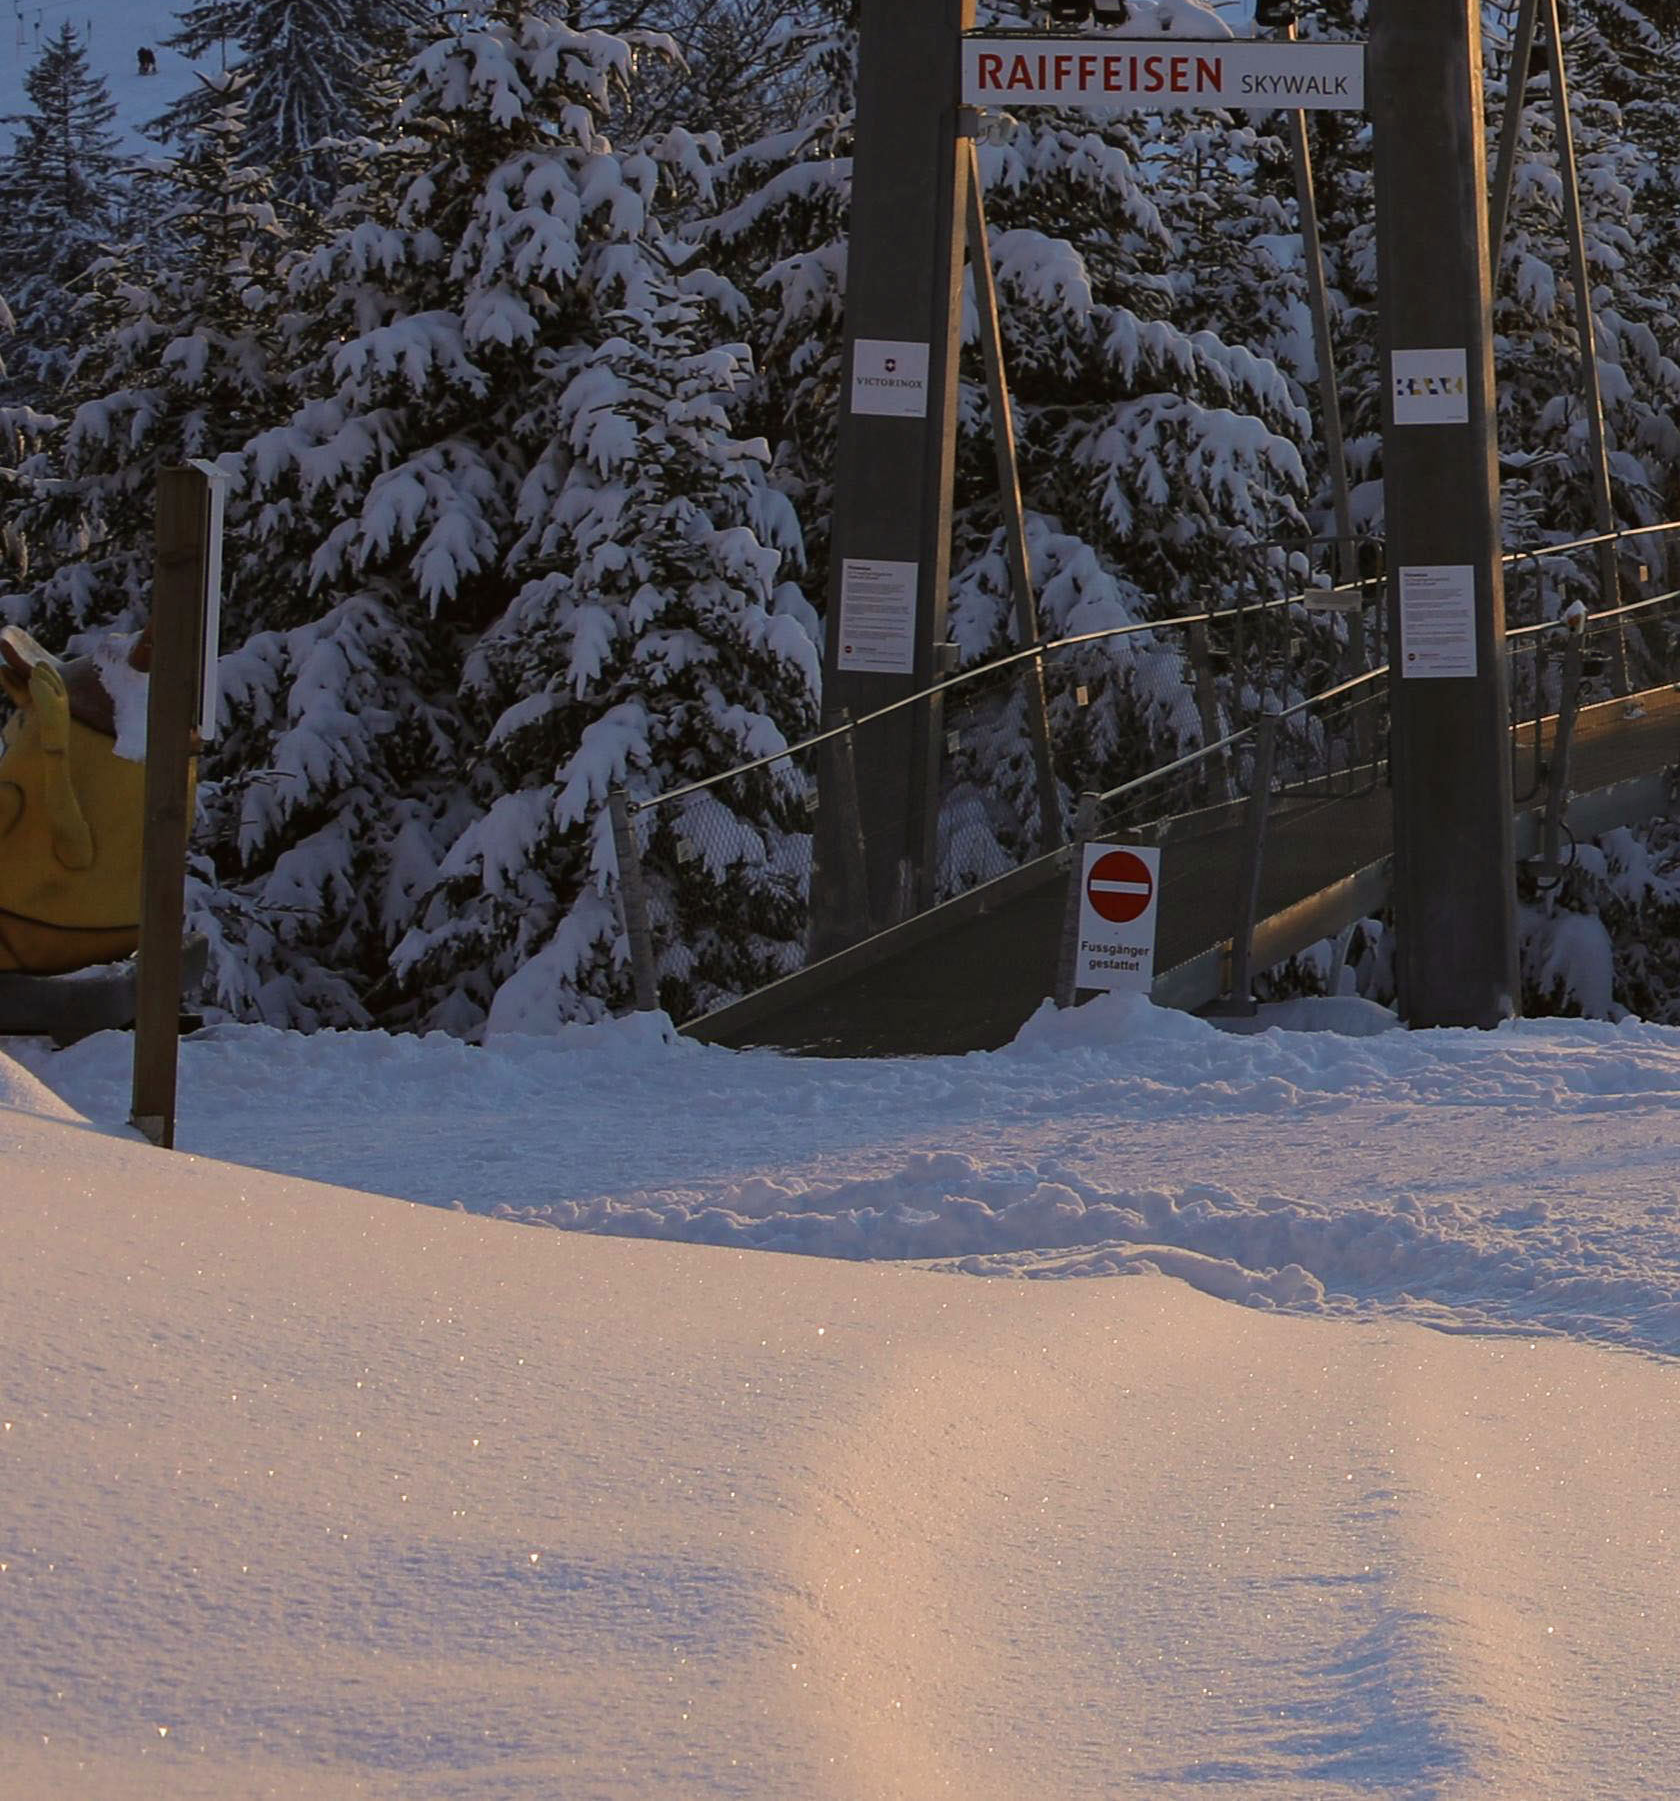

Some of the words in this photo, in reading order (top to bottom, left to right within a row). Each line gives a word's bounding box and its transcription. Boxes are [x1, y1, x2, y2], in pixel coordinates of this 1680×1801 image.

[977, 53, 1223, 93] RAIFFEISEN
[1241, 74, 1349, 96] SKYWALK
[856, 376, 923, 389] VICTORINOX
[1081, 941, 1149, 957] Fussgänger
[1089, 959, 1139, 971] gestattet
